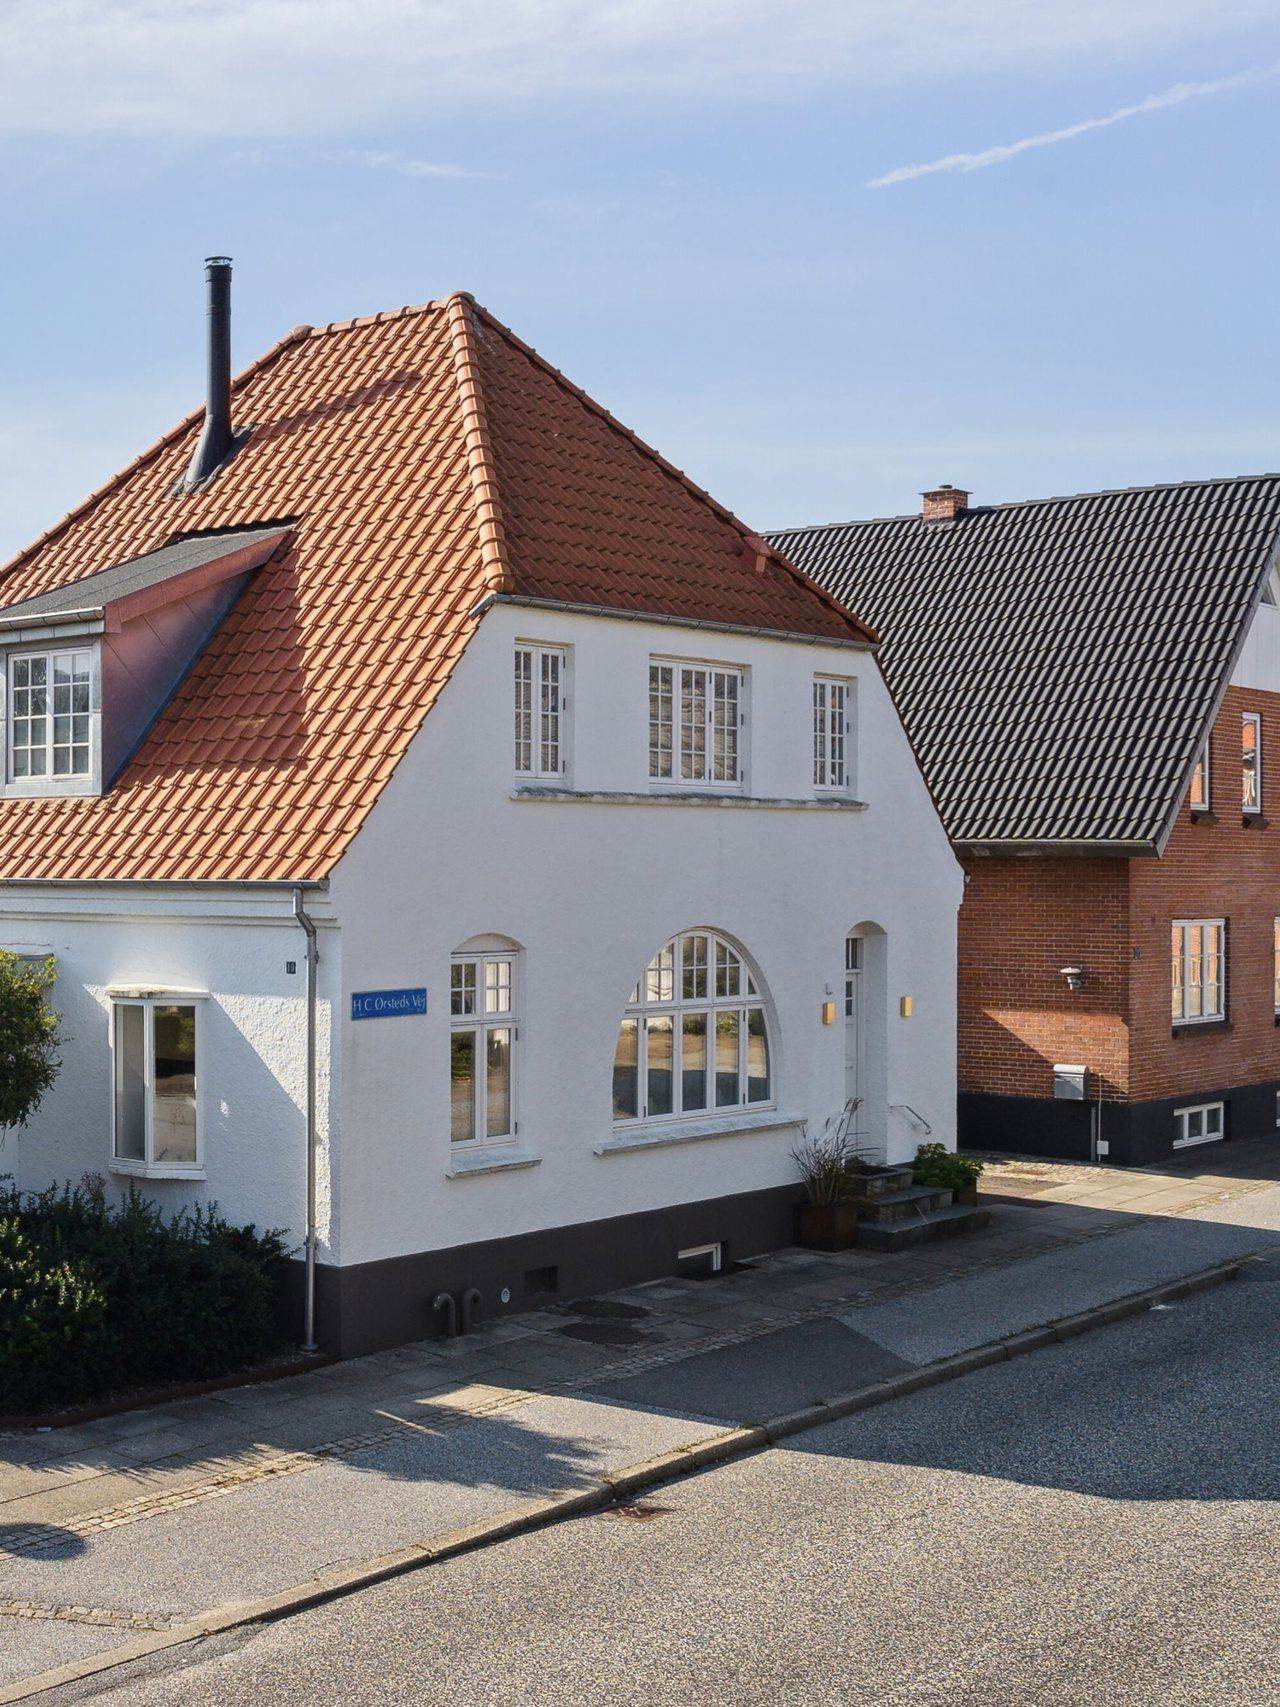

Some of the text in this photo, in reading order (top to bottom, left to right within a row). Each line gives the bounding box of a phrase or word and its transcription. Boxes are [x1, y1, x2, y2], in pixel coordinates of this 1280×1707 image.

[353, 994, 426, 1011] H C Ørsteds Vej
